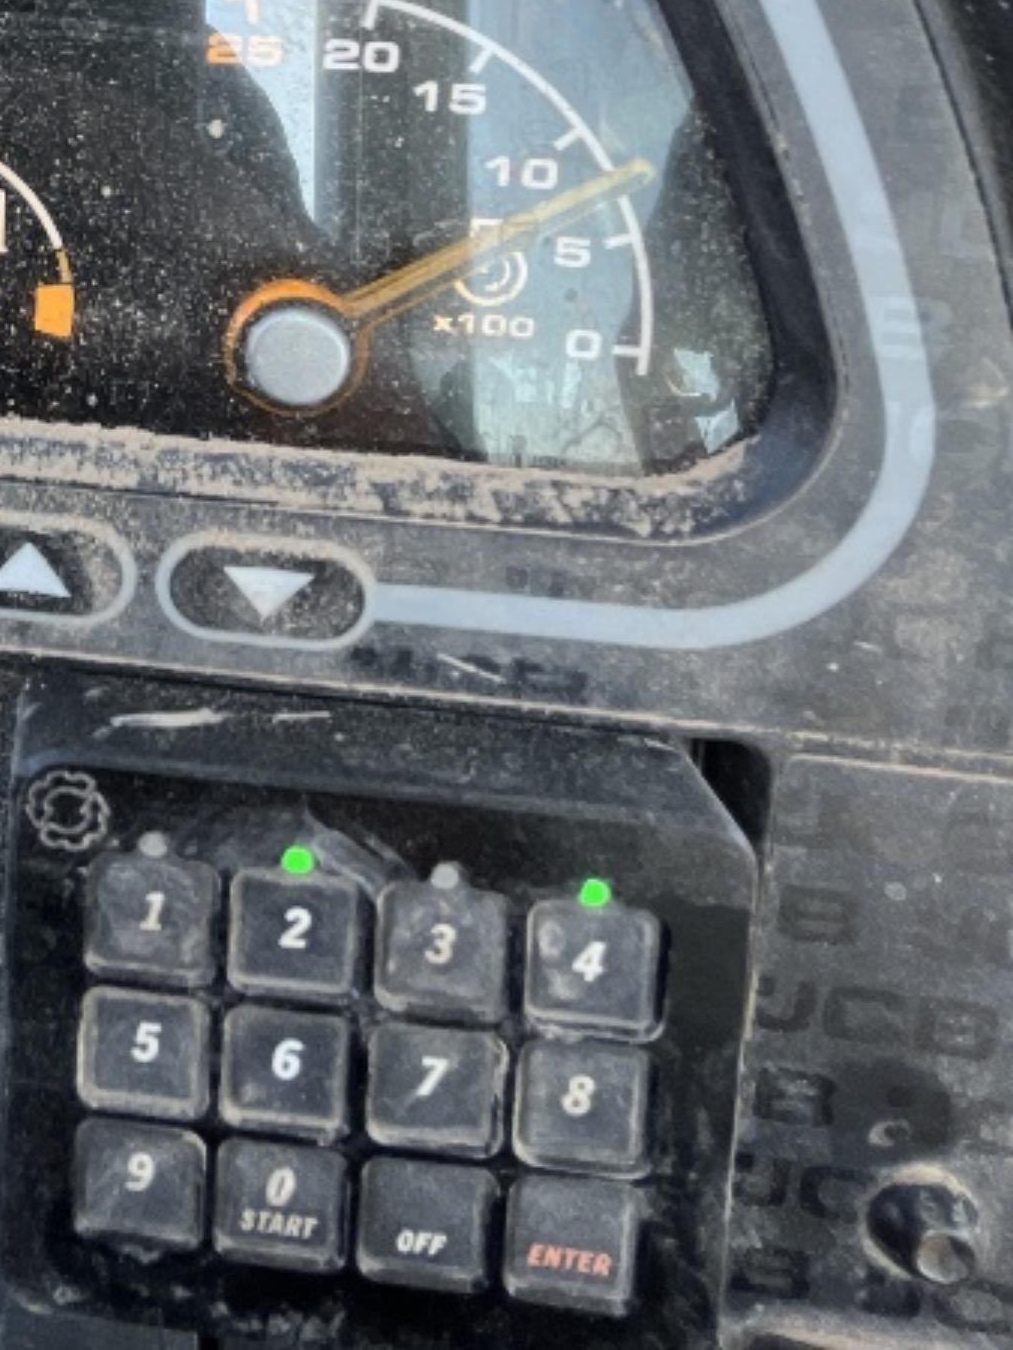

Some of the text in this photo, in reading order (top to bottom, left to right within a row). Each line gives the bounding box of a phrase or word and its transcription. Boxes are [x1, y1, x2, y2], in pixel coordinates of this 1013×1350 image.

[206, 34, 284, 65] 25
[323, 38, 401, 73] 20
[414, 80, 487, 116] 15
[486, 155, 559, 191] 10
[554, 237, 591, 269] 5
[433, 313, 536, 339] x100
[565, 328, 603, 362] 0
[139, 892, 165, 931] 1
[278, 906, 313, 949] 2
[424, 923, 457, 965] 3
[571, 941, 607, 983] 4
[131, 1021, 163, 1063] 5
[271, 1038, 305, 1080] 6
[416, 1054, 449, 1098] 7
[561, 1074, 596, 1118] 8
[125, 1152, 155, 1191] 9
[266, 1168, 296, 1206] 0
[239, 1208, 318, 1240] START
[396, 1229, 448, 1257] OFF
[526, 1241, 613, 1277] ENTER
